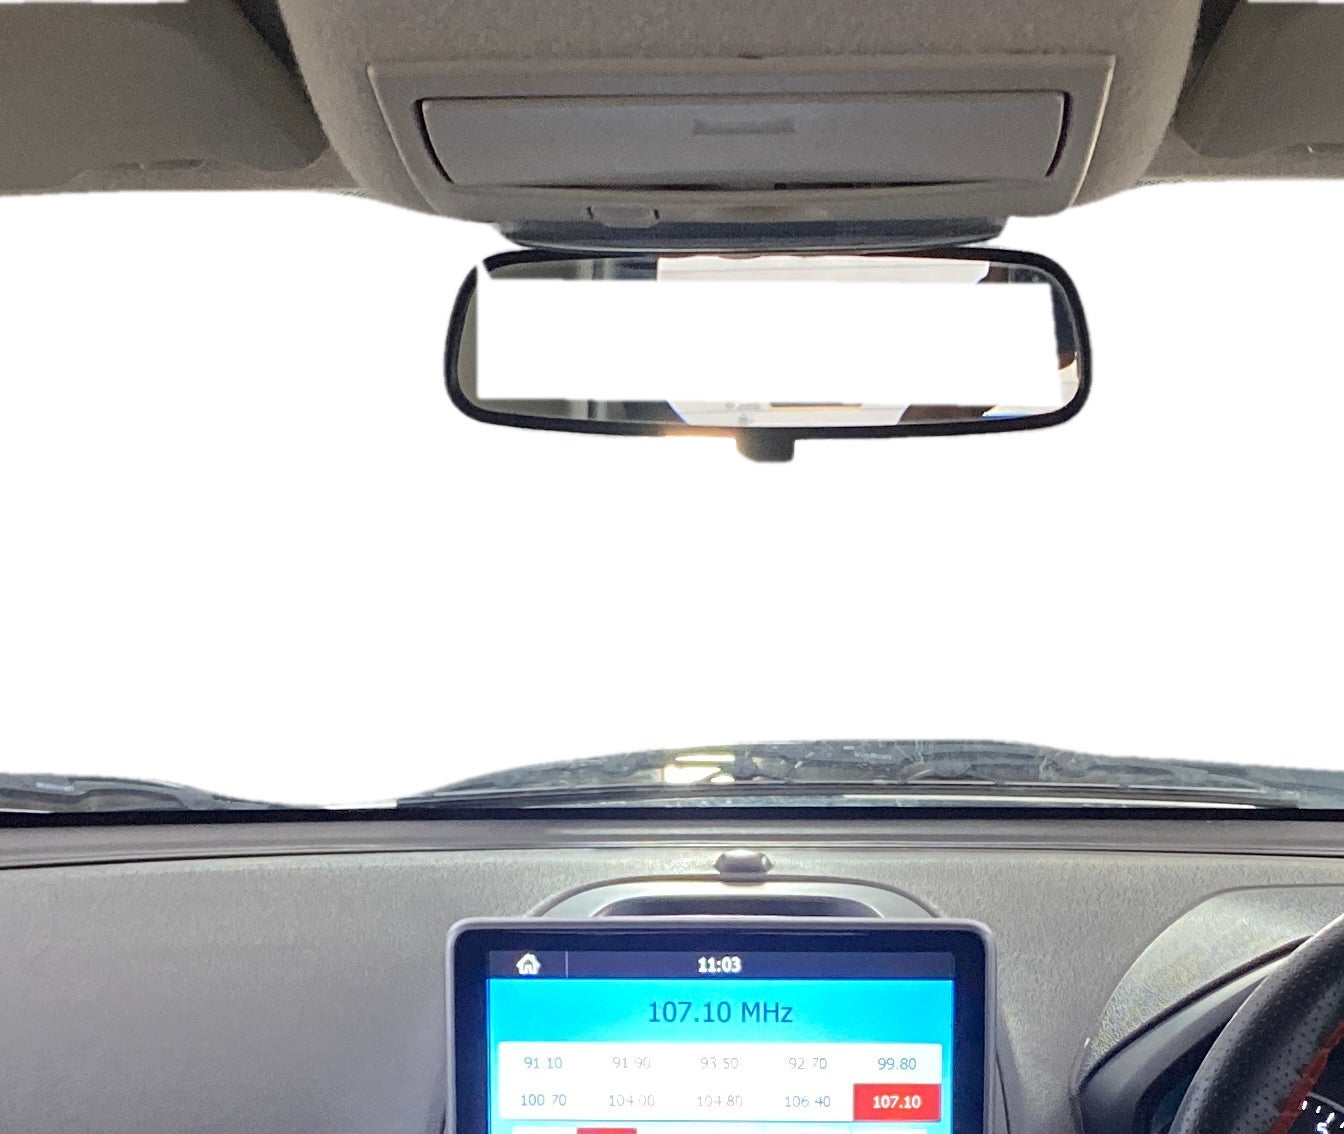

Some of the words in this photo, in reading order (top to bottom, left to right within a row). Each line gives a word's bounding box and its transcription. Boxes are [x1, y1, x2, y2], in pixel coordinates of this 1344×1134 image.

[698, 956, 741, 973] 11:03
[649, 1001, 731, 1022] 107.10
[742, 1001, 793, 1022] MHz
[524, 1057, 563, 1069] 9110
[612, 1057, 651, 1069] 9190
[700, 1057, 738, 1069] 9350
[788, 1057, 827, 1069] 9270
[877, 1058, 916, 1070] 99.80
[521, 1094, 567, 1106] 10070
[609, 1095, 655, 1107] 10400
[698, 1095, 743, 1107] 10480
[785, 1096, 831, 1108] 10640
[873, 1095, 921, 1109] 107.10
